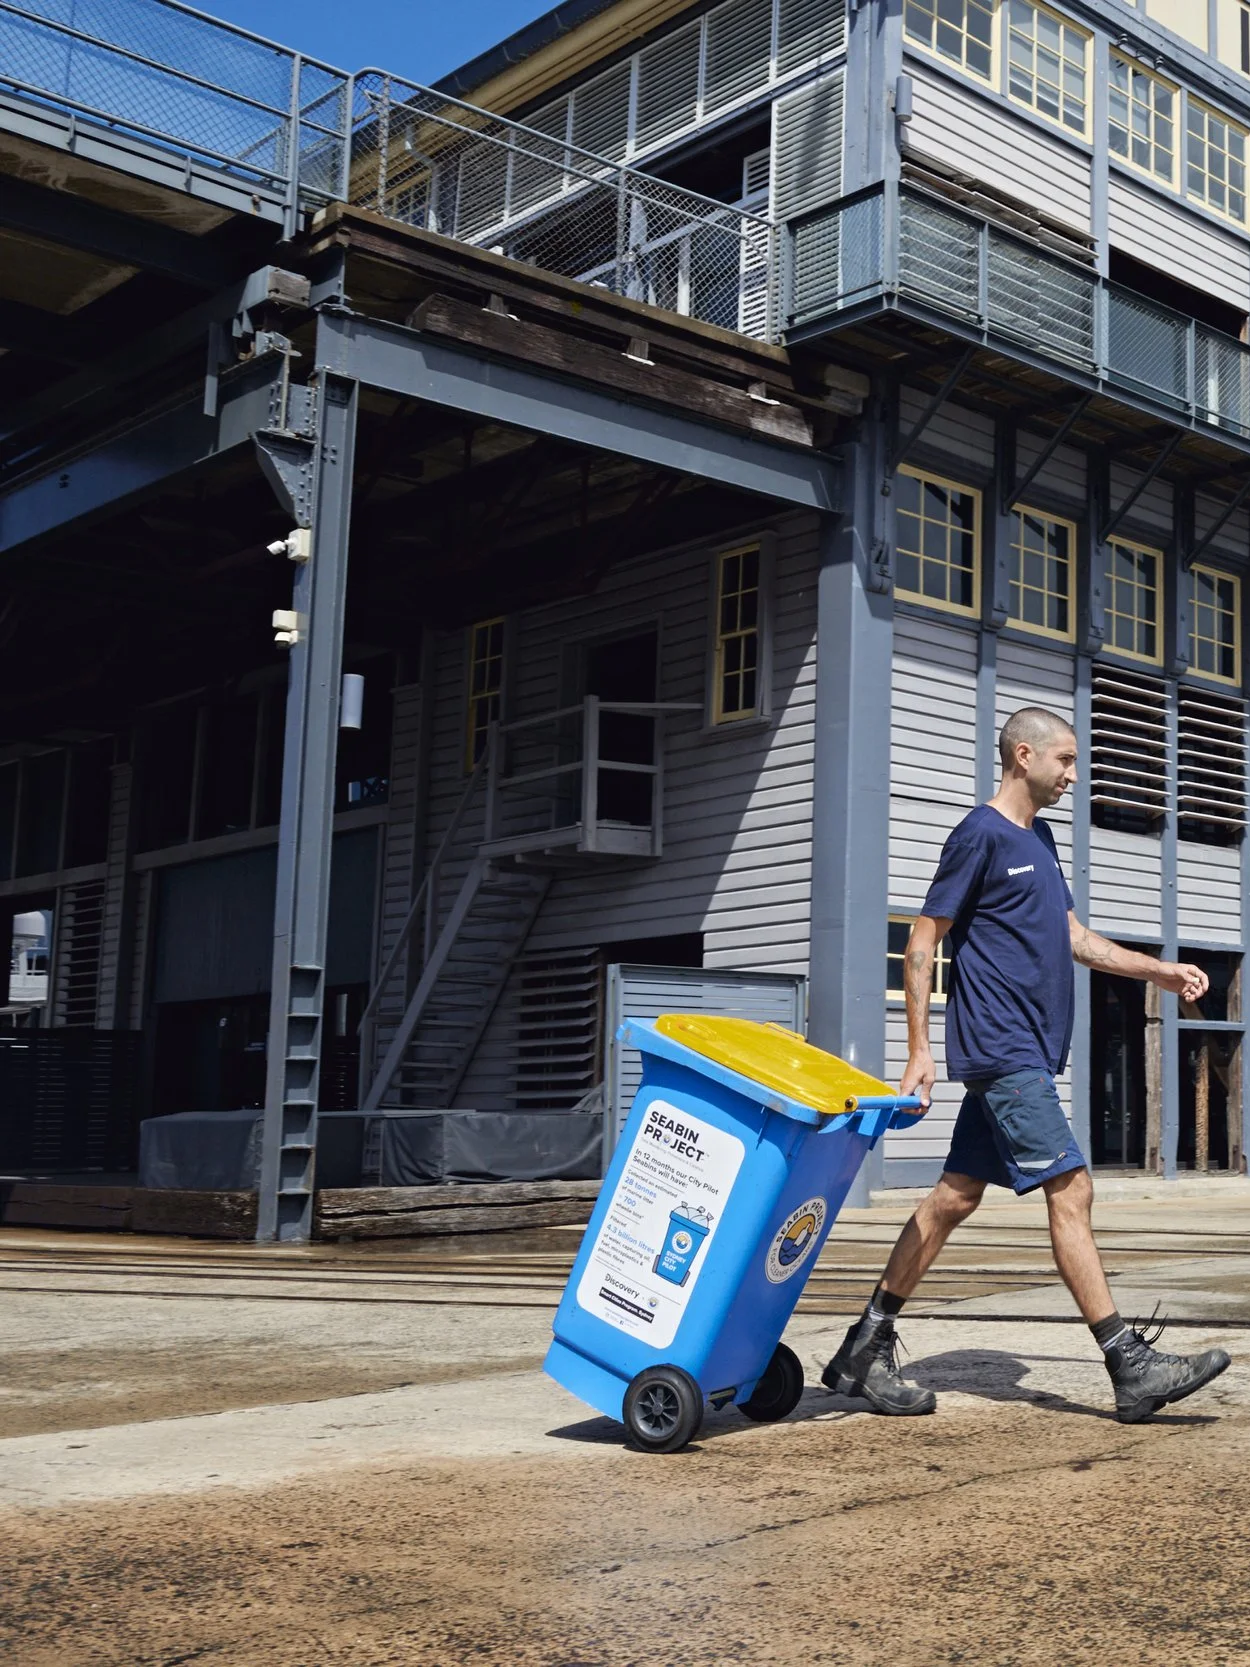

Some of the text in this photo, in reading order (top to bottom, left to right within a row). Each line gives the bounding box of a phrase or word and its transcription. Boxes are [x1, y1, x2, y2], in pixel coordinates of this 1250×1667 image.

[1008, 865, 1034, 876] Discovery
[649, 1110, 699, 1144] SEABIN
[632, 1155, 688, 1188] Seabins will have:
[635, 1148, 719, 1195] In 12 months our City Pilot
[624, 1176, 657, 1198] 28 tonnes
[627, 1168, 648, 1182] Collected
[654, 1183, 677, 1198] estimated
[623, 1195, 636, 1207] 700
[626, 1188, 642, 1198] marine
[609, 1215, 626, 1227] Filtered
[776, 1201, 823, 1242] SEABIN PROJECT
[606, 1223, 655, 1254] 4.3 billion litres
[621, 1243, 643, 1258] capturing
[665, 1249, 686, 1264] SYDNEY
[661, 1260, 676, 1272] PILOT
[663, 1255, 676, 1265] CITY
[603, 1272, 640, 1300] Discovery
